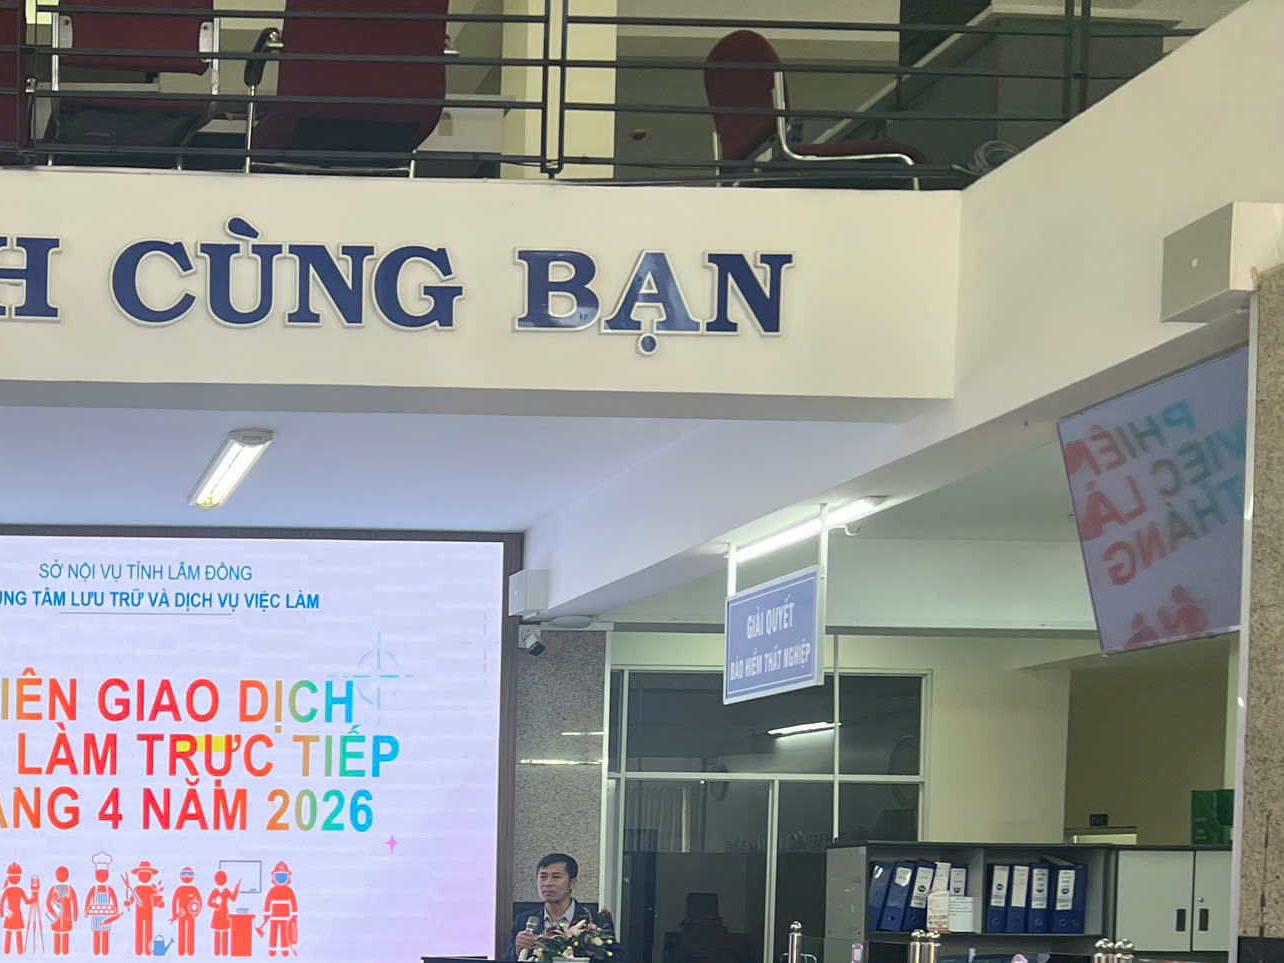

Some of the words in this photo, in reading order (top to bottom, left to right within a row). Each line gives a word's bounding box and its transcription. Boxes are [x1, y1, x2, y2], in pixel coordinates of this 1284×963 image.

[112, 217, 464, 330] CÙNG
[515, 248, 795, 355] BẠN
[39, 561, 63, 579] SỞ
[68, 562, 96, 583] NỘI
[100, 564, 122, 582] VỤ
[128, 561, 164, 580] TỈNH
[167, 562, 201, 581] LÂM
[205, 562, 253, 581] ĐỒNG
[32, 587, 66, 606] TÂM
[71, 589, 105, 607] LƯU
[110, 588, 144, 607] TRỮ
[148, 588, 170, 608] VÀ
[175, 591, 213, 612] DỊCH
[217, 592, 239, 612] VỤ
[244, 590, 281, 613] VIỆC
[286, 589, 320, 609] LÀM
[747, 605, 764, 639] GIẢI
[766, 593, 794, 636] QUYẾT
[97, 678, 219, 722] GIAO
[239, 679, 354, 733] DỊCH
[17, 722, 117, 776] LÀM
[136, 732, 274, 787] TRỰC
[293, 724, 400, 777] TIẾP
[98, 788, 123, 830] 4
[143, 777, 247, 831] NĂM
[266, 789, 373, 833] 2026
